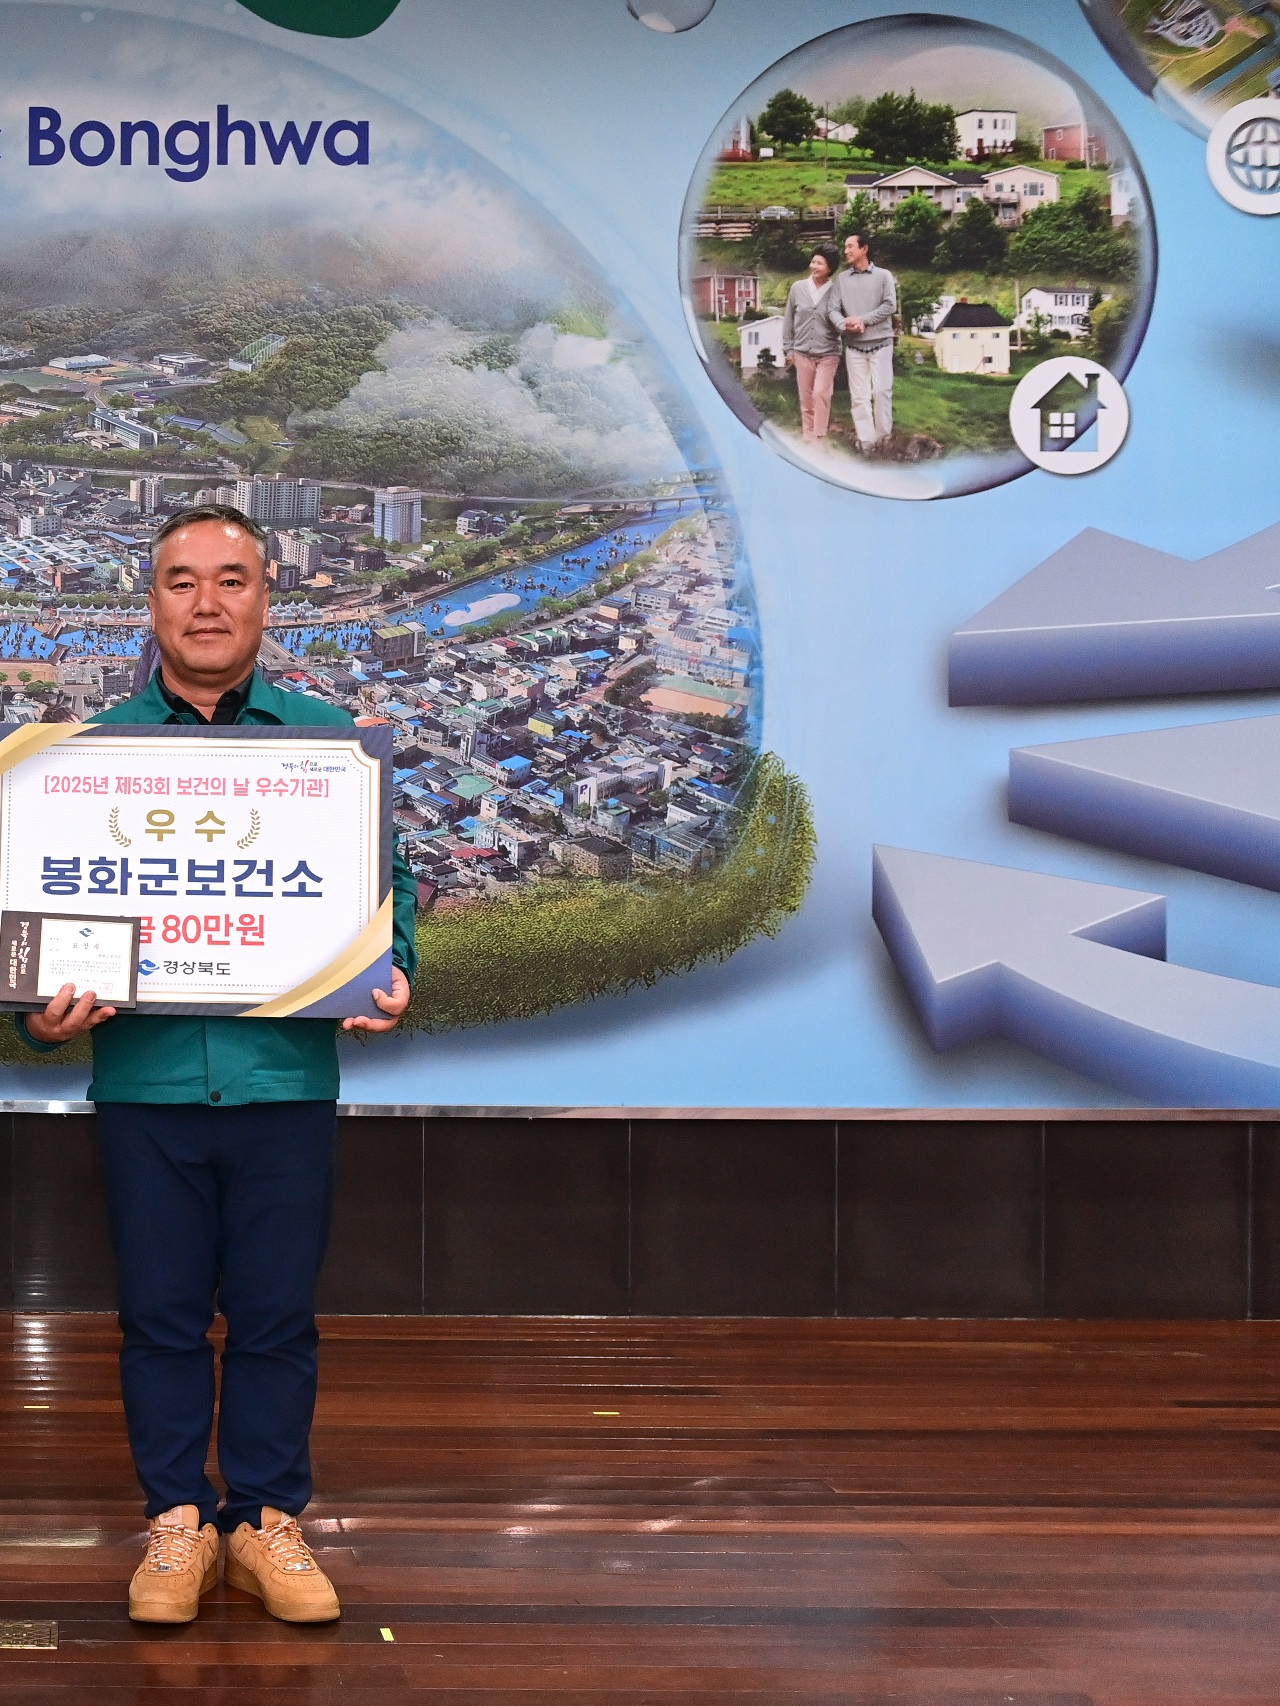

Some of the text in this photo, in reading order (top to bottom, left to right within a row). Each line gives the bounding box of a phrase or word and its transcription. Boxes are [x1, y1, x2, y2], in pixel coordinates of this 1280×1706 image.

[27, 104, 370, 183] Bonghwa
[44, 775, 329, 798] [2025년 제53회 보건의 날 우수기관]
[40, 855, 324, 899] 봉화군보건소
[161, 913, 265, 946] 80만원
[163, 960, 231, 976] 경상북도
